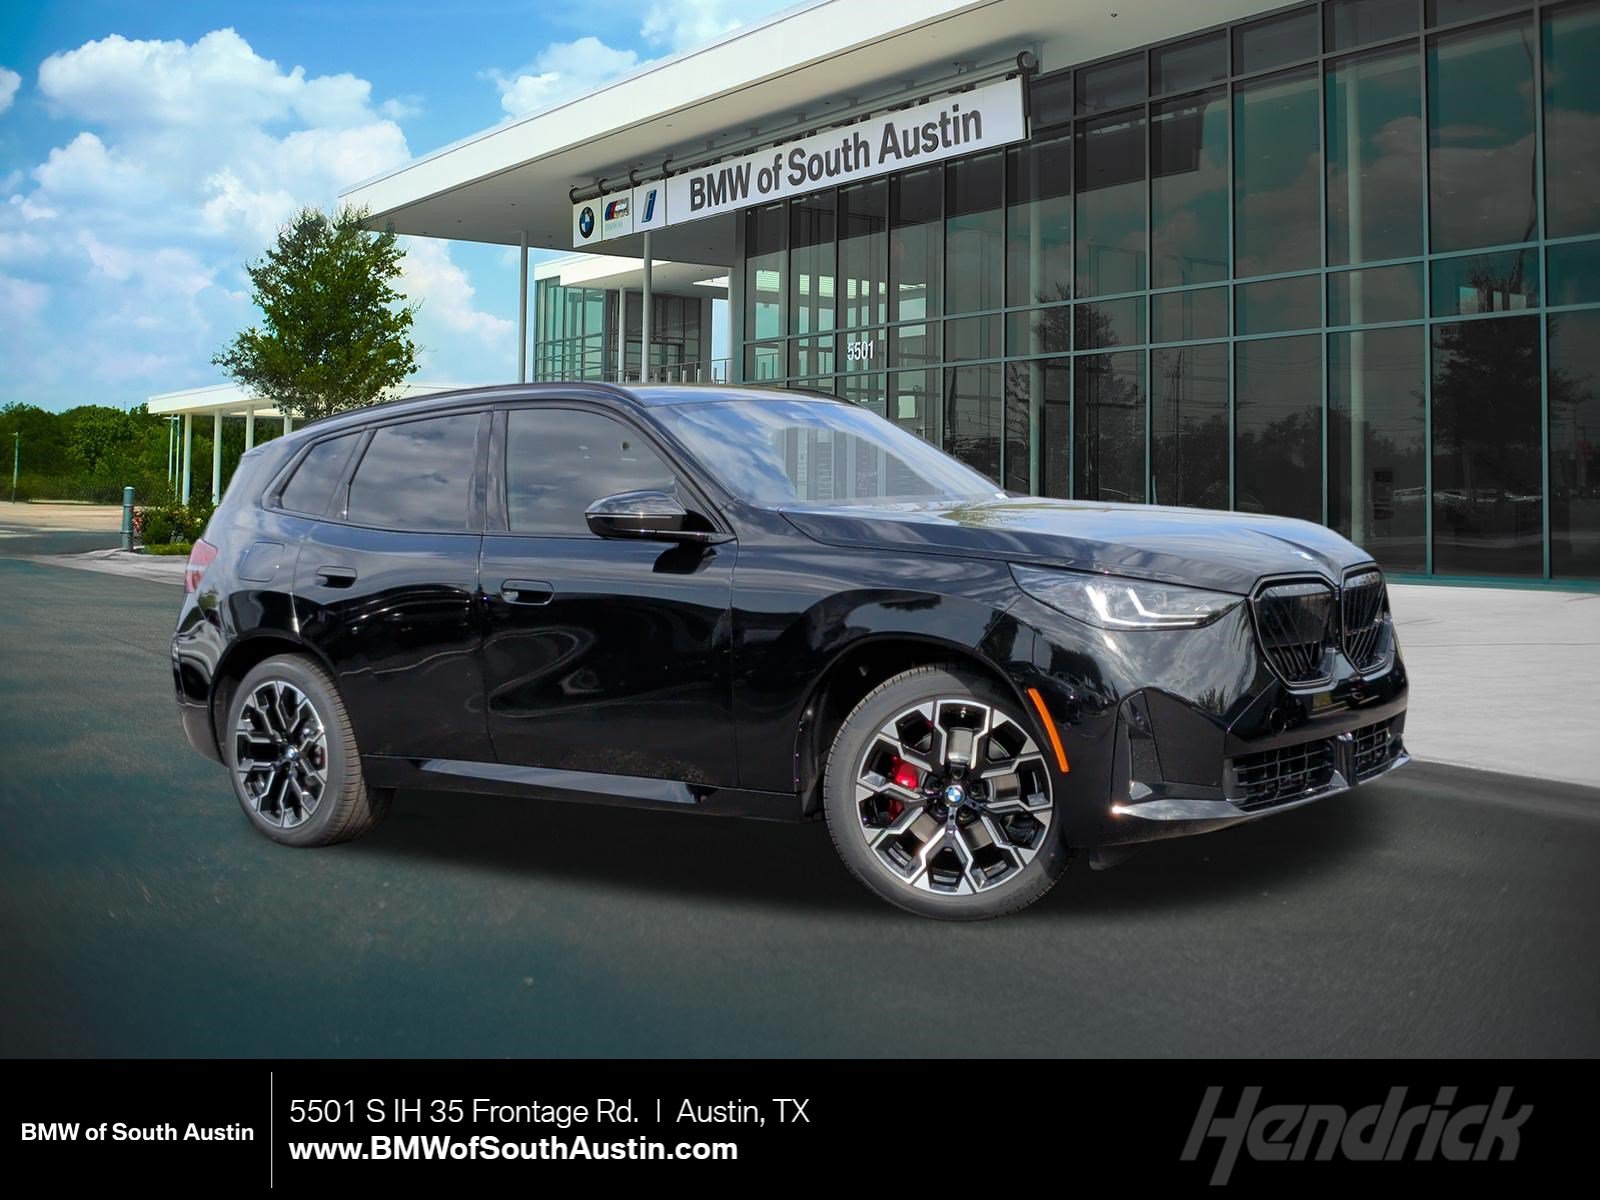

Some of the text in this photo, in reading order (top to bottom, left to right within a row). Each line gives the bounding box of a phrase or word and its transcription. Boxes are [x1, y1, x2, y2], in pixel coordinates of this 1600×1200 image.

[689, 103, 983, 213] BMW of South Austin
[847, 340, 874, 360] 5501
